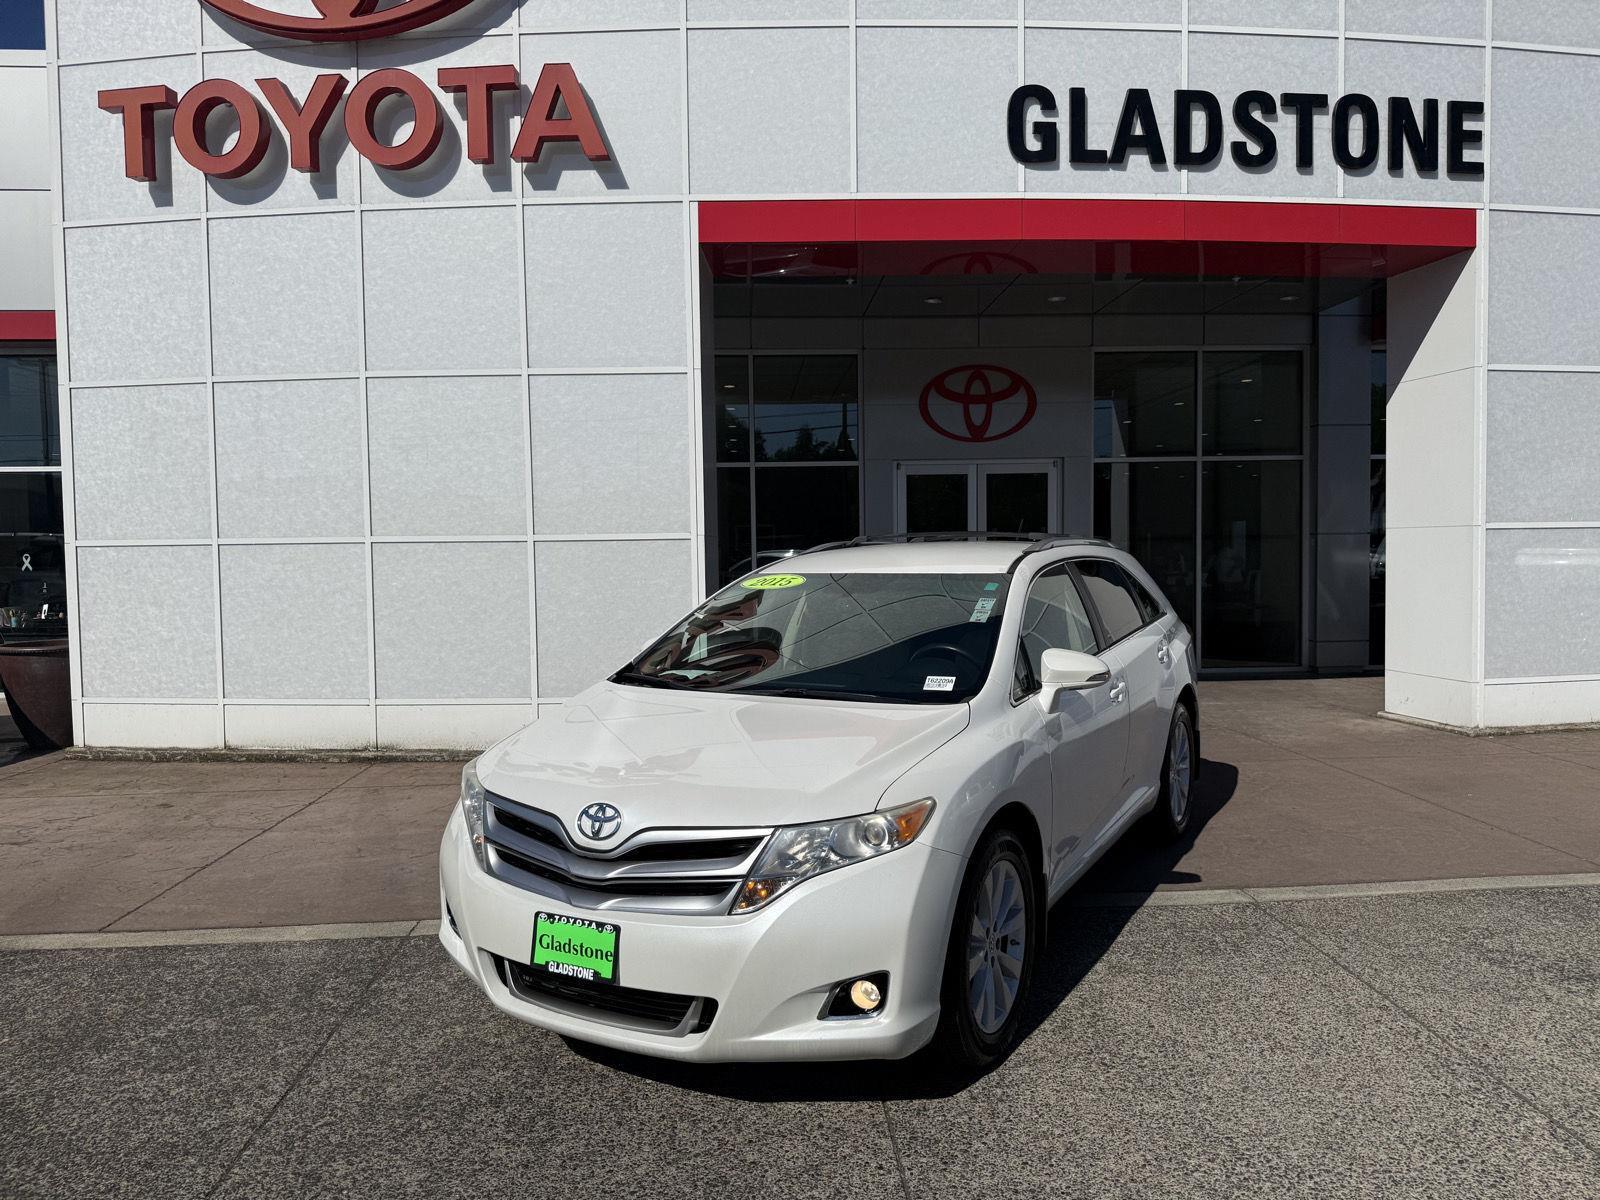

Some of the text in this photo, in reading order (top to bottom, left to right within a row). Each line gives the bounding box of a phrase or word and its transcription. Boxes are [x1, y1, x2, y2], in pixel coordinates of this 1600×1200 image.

[98, 62, 610, 183] TOYOTA
[1006, 84, 1485, 180] GLADSTONE
[748, 577, 798, 587] 2015
[554, 915, 597, 930] TOYOTA
[538, 933, 614, 963] Gladstone
[548, 961, 594, 981] GLADSTONE
